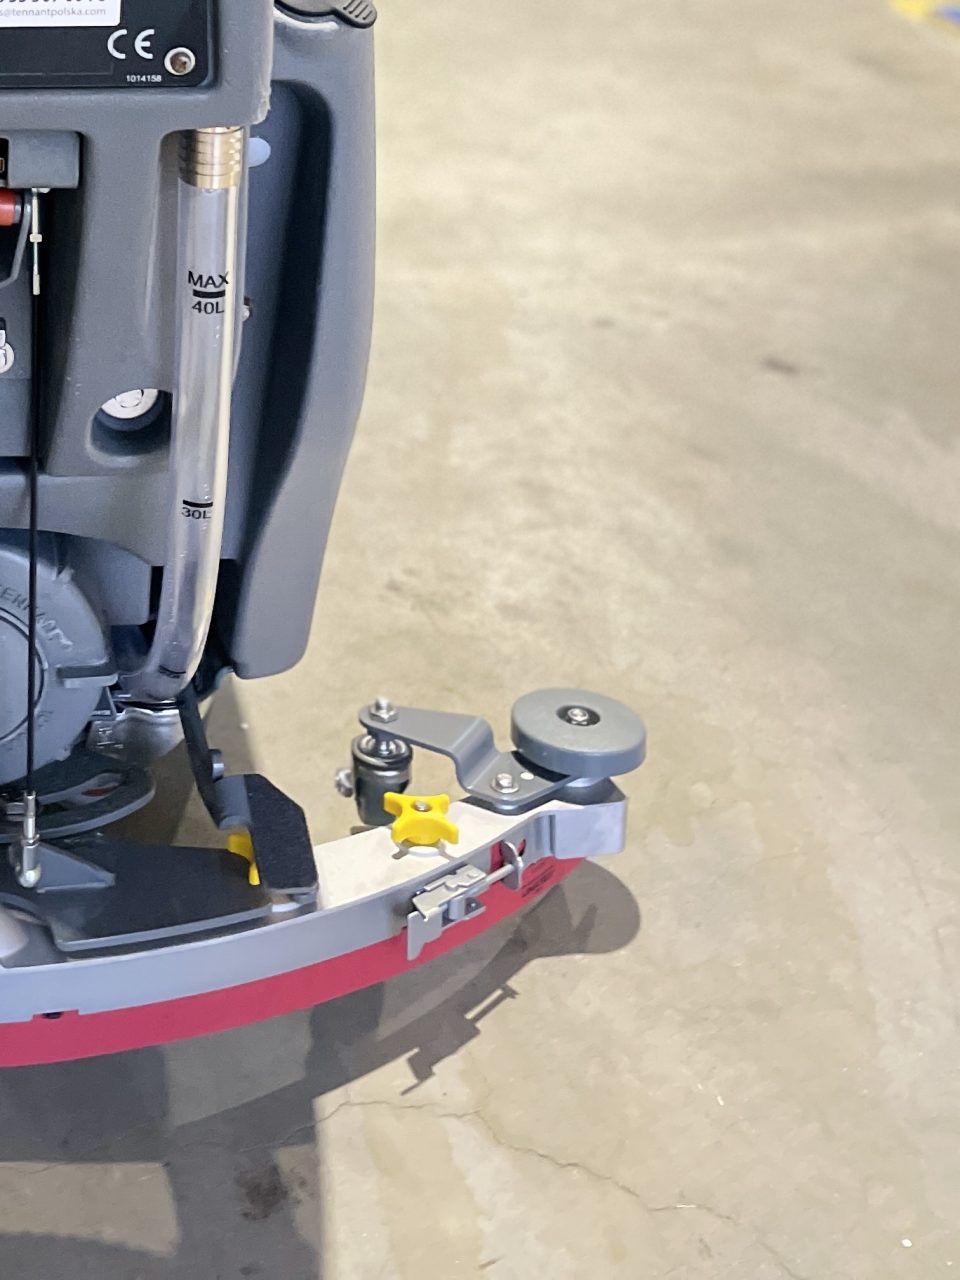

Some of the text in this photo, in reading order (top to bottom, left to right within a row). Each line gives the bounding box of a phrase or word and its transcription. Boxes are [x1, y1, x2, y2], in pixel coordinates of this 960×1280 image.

[187, 270, 229, 289] MAX
[192, 300, 225, 315] 40L
[181, 506, 212, 520] 30L
